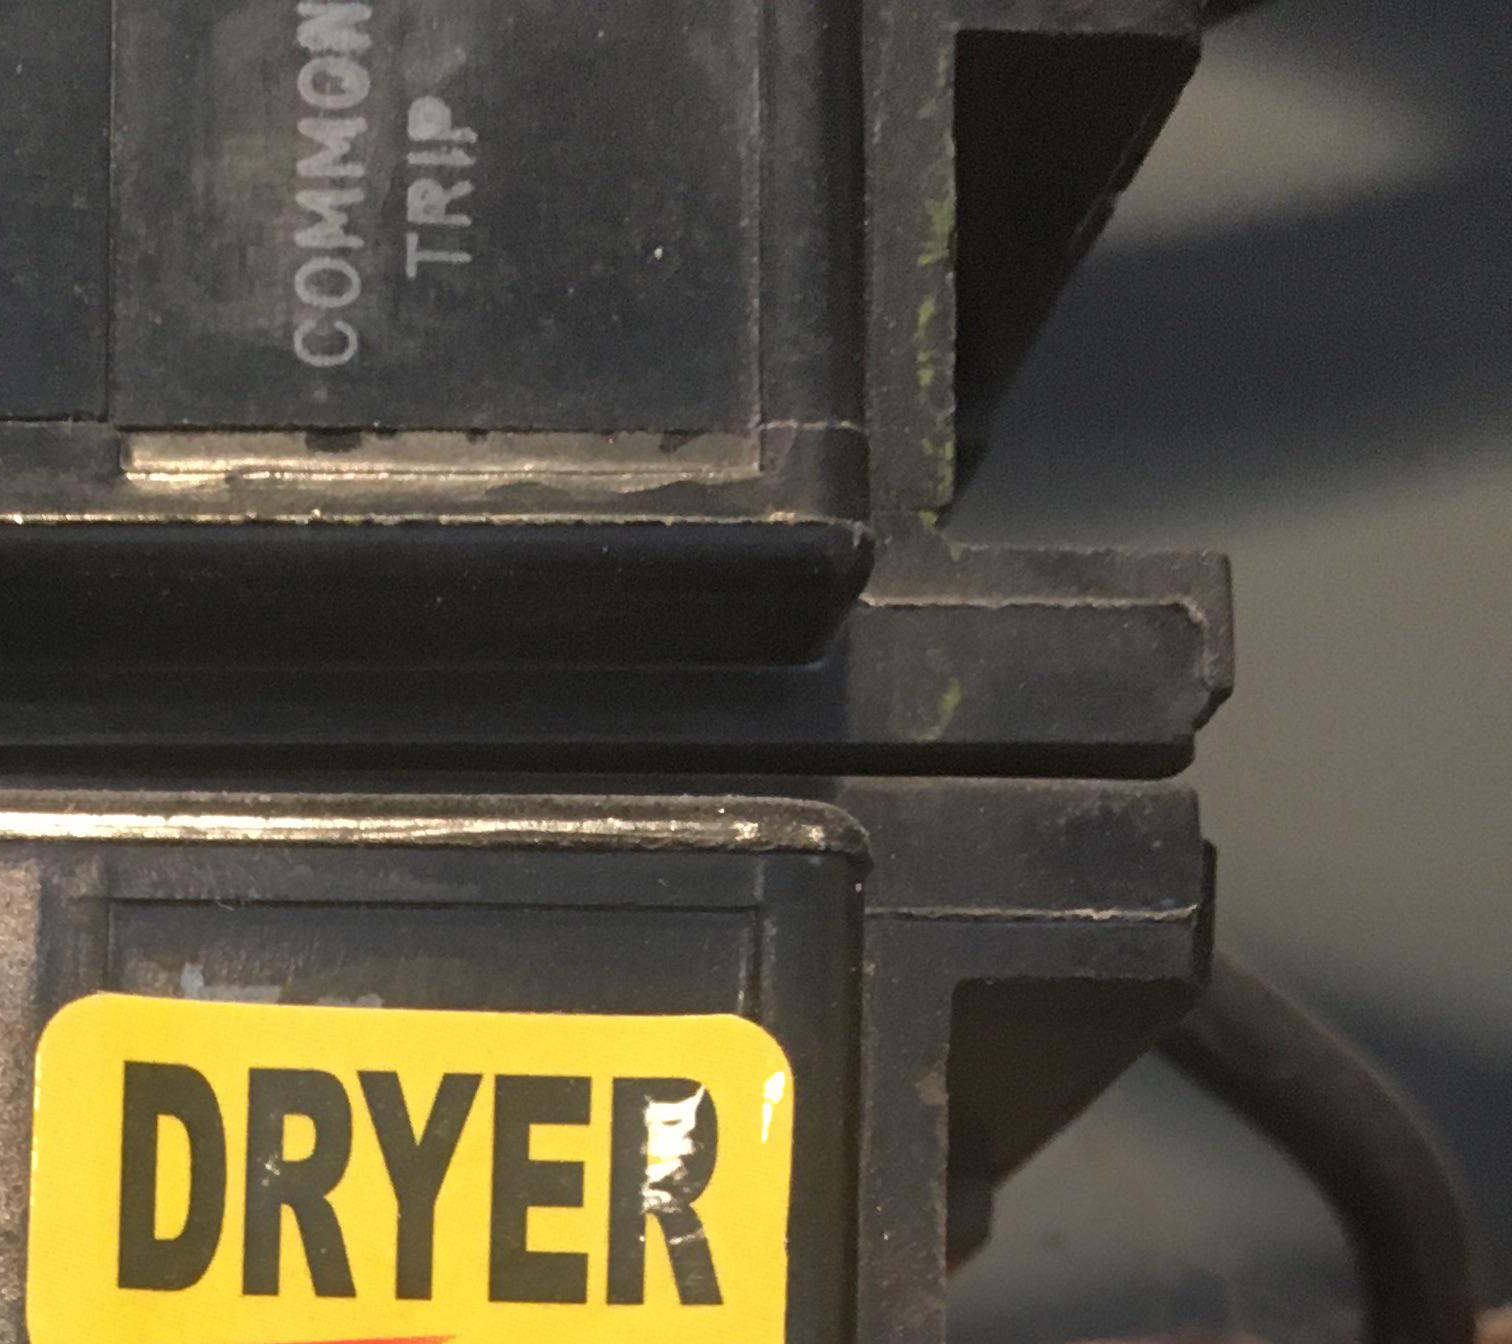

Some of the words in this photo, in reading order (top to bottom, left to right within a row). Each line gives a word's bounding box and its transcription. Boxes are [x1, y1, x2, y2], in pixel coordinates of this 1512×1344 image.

[293, 0, 372, 367] COMMON
[405, 96, 478, 279] TRIP
[116, 1060, 724, 1306] DRYER
